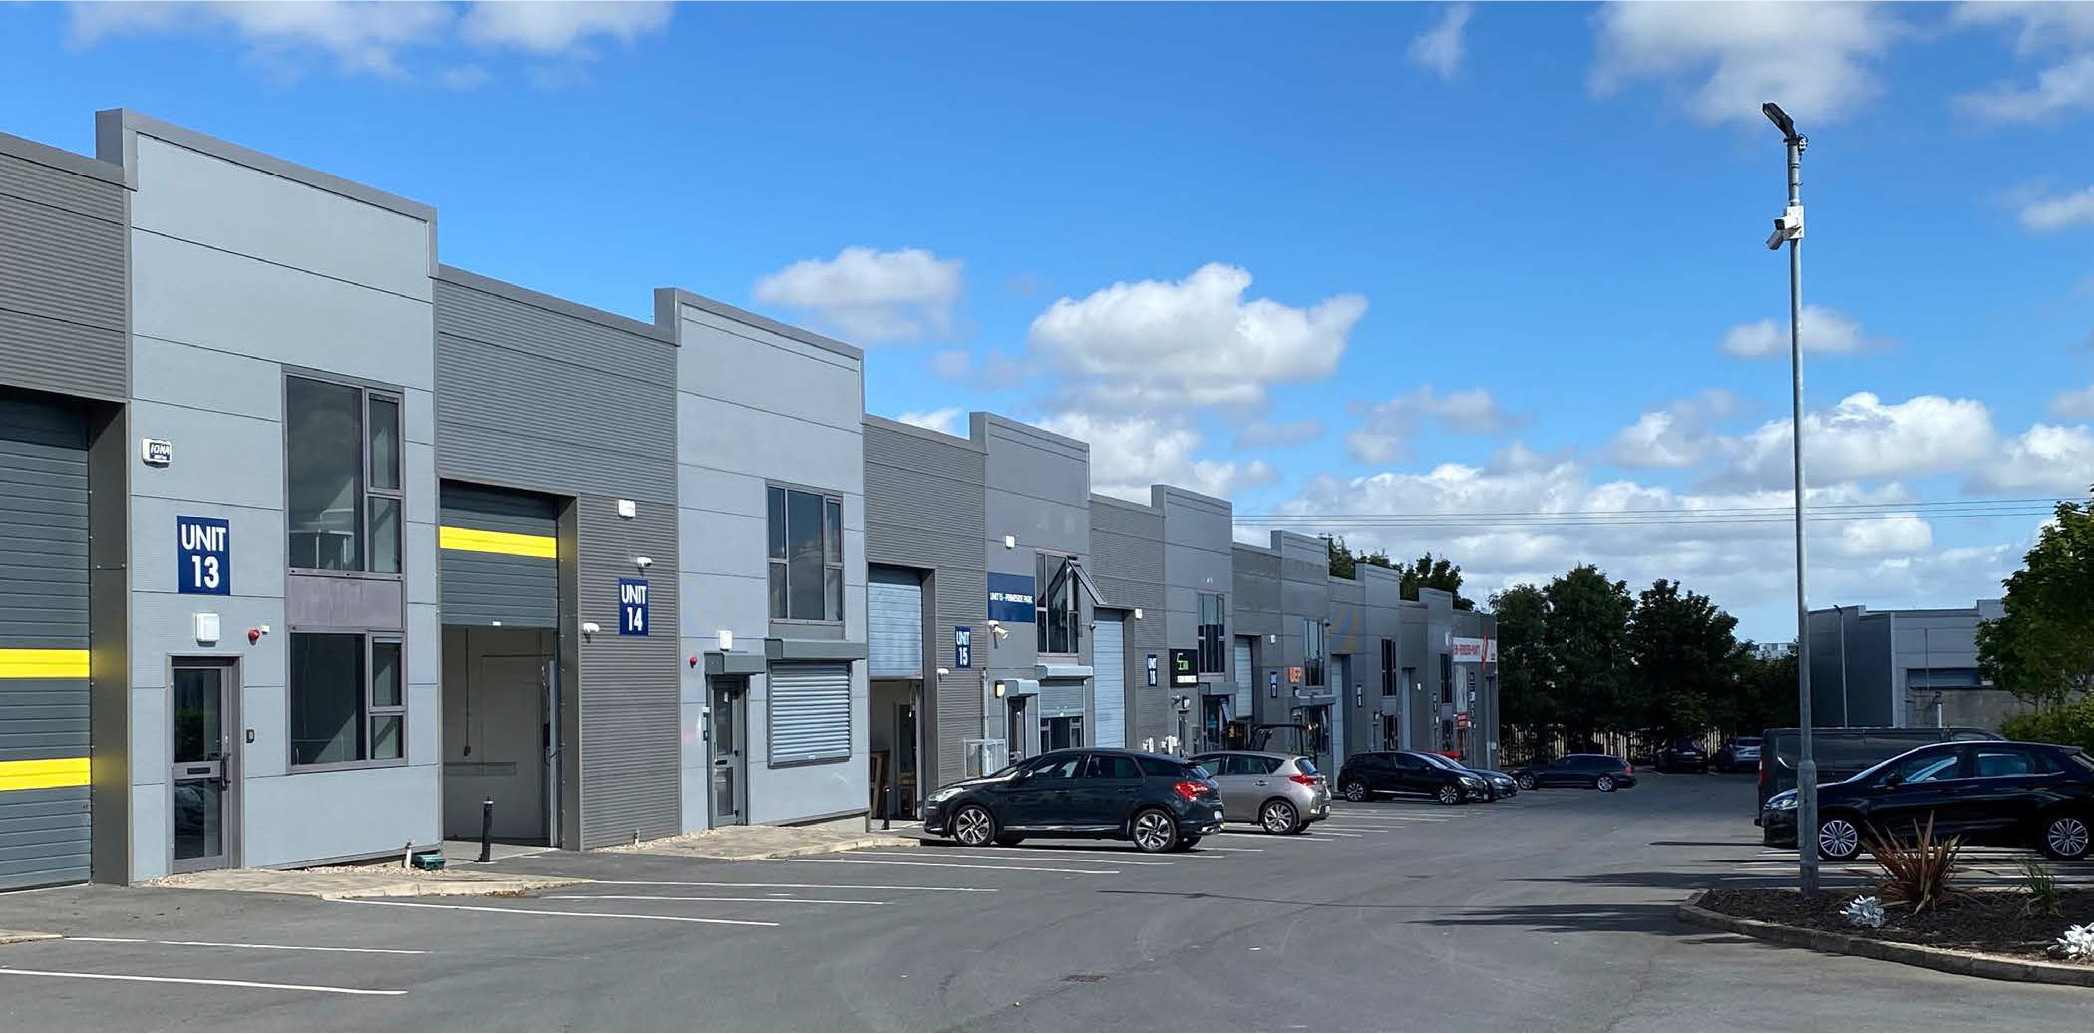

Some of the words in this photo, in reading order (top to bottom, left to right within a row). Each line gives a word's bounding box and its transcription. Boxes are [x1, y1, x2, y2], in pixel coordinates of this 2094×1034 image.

[150, 443, 170, 455] IONA
[181, 524, 226, 551] UNIT
[191, 555, 220, 589] 13
[621, 584, 647, 605] UNIT
[627, 606, 643, 632] 14
[956, 631, 970, 645] UNIT
[959, 647, 968, 665] 15
